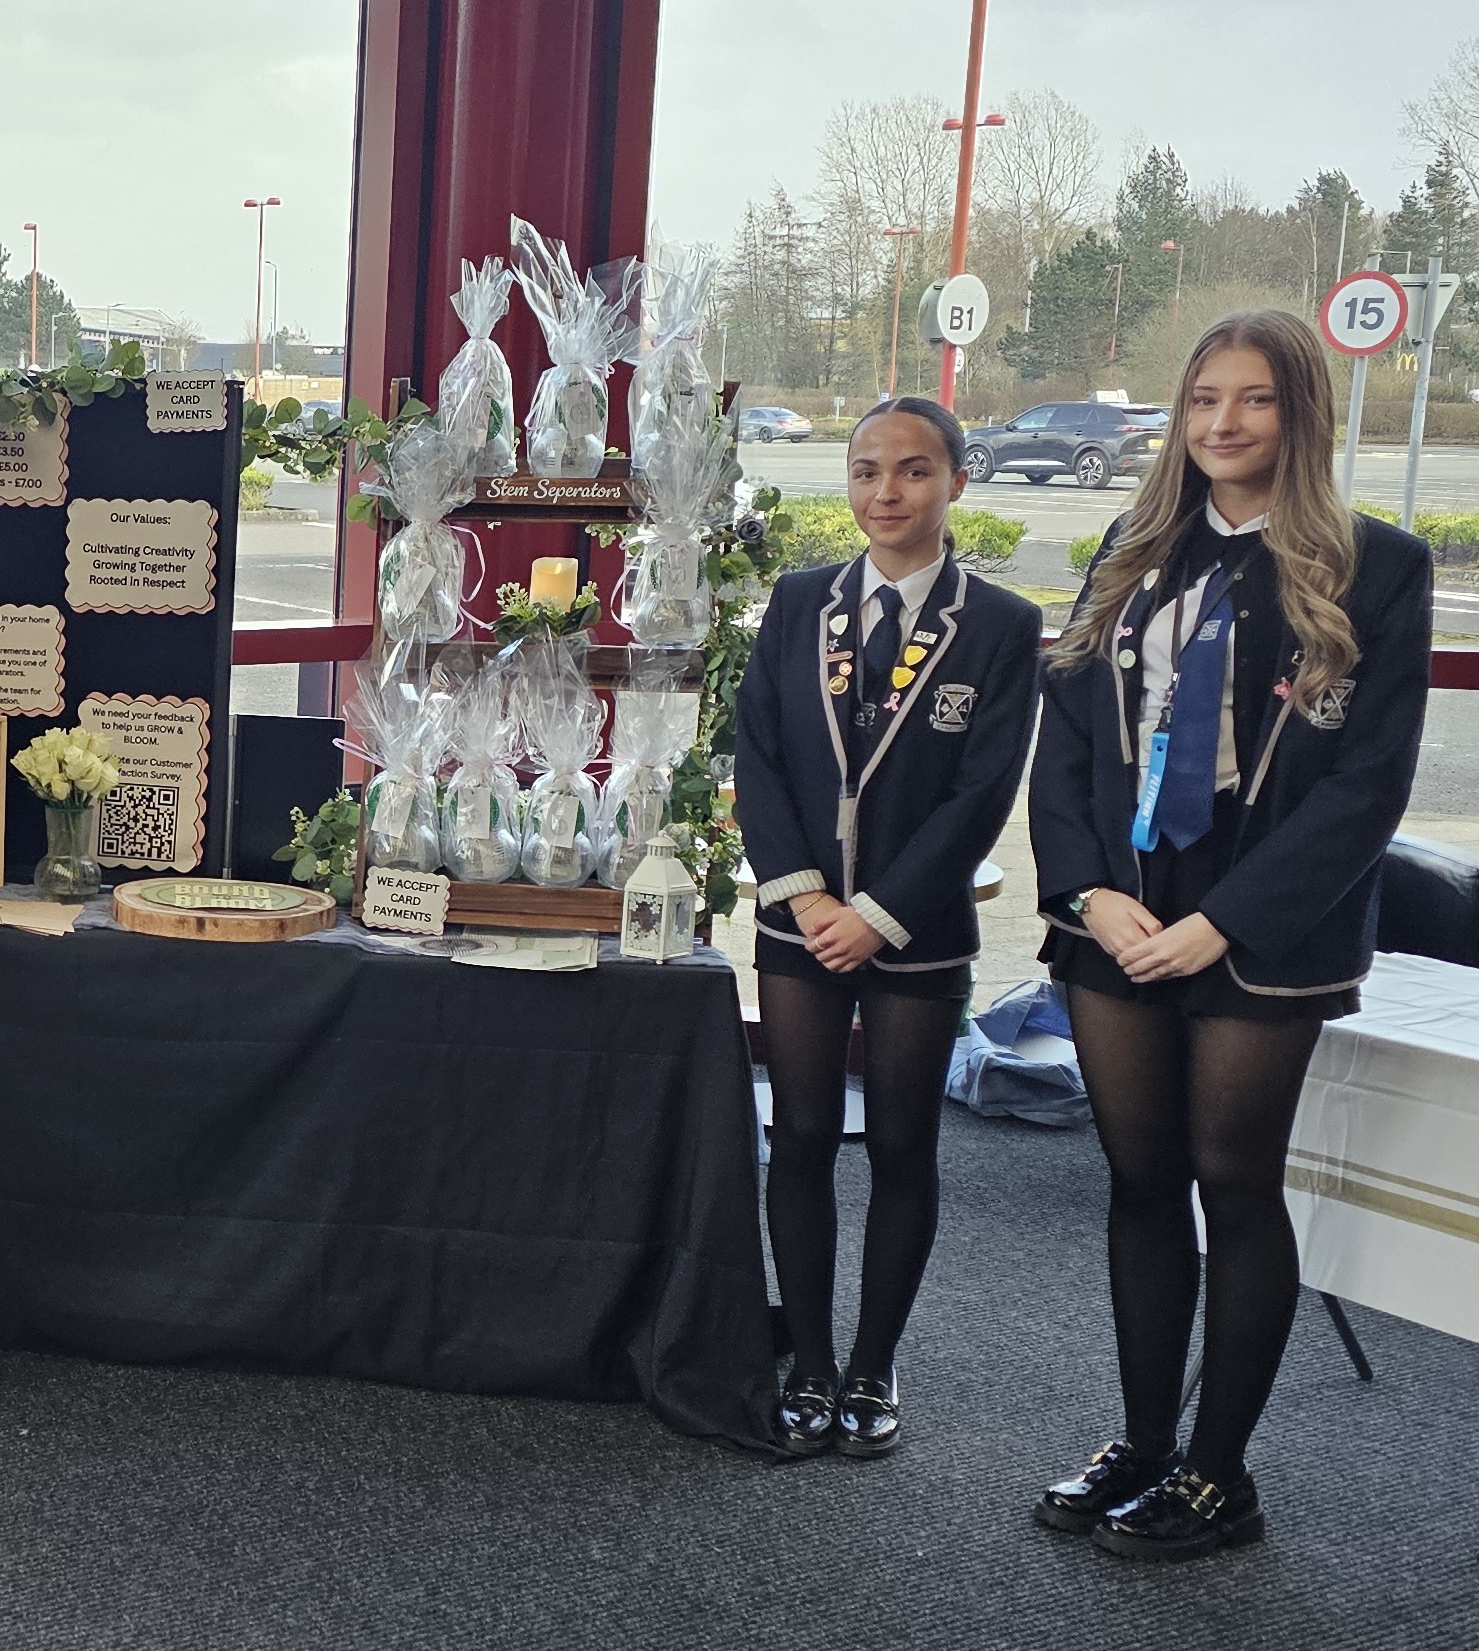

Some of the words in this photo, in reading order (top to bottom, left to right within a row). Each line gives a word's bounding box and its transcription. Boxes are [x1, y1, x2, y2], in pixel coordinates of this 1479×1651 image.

[950, 306, 974, 331] B1
[1345, 298, 1385, 330] 15
[156, 381, 172, 390] WE
[174, 380, 215, 389] ACCEPT
[171, 395, 200, 404] CARD
[157, 410, 212, 419] PAYMENTS
[15, 478, 42, 489] £7.00
[486, 478, 528, 498] Stem
[533, 479, 621, 504] Seperators
[110, 513, 130, 523] Our
[132, 514, 171, 525] Values:
[83, 543, 141, 557] Cultivating
[143, 546, 195, 560] Creativity
[93, 559, 137, 573] Growing
[139, 561, 187, 574] Together
[89, 575, 127, 586] Rooted
[142, 577, 186, 590] Respect
[10, 616, 27, 624] your
[29, 616, 50, 624] home
[10, 687, 29, 695] team
[92, 708, 105, 716] We
[108, 710, 130, 718] need
[131, 712, 152, 720] your
[154, 712, 195, 723] feedback
[113, 722, 133, 732] help
[147, 725, 175, 734] GROW
[177, 727, 183, 735] &
[124, 736, 159, 745] BLOOM.
[150, 758, 193, 769] Customer
[118, 768, 148, 778] faction
[151, 771, 182, 782] Survey.
[174, 884, 270, 899] BOUND
[377, 876, 394, 887] WE
[396, 879, 440, 893] ACCEPT
[175, 894, 271, 909] BLOOM
[391, 893, 421, 905] CARD
[373, 905, 432, 922] PAYMENTS
